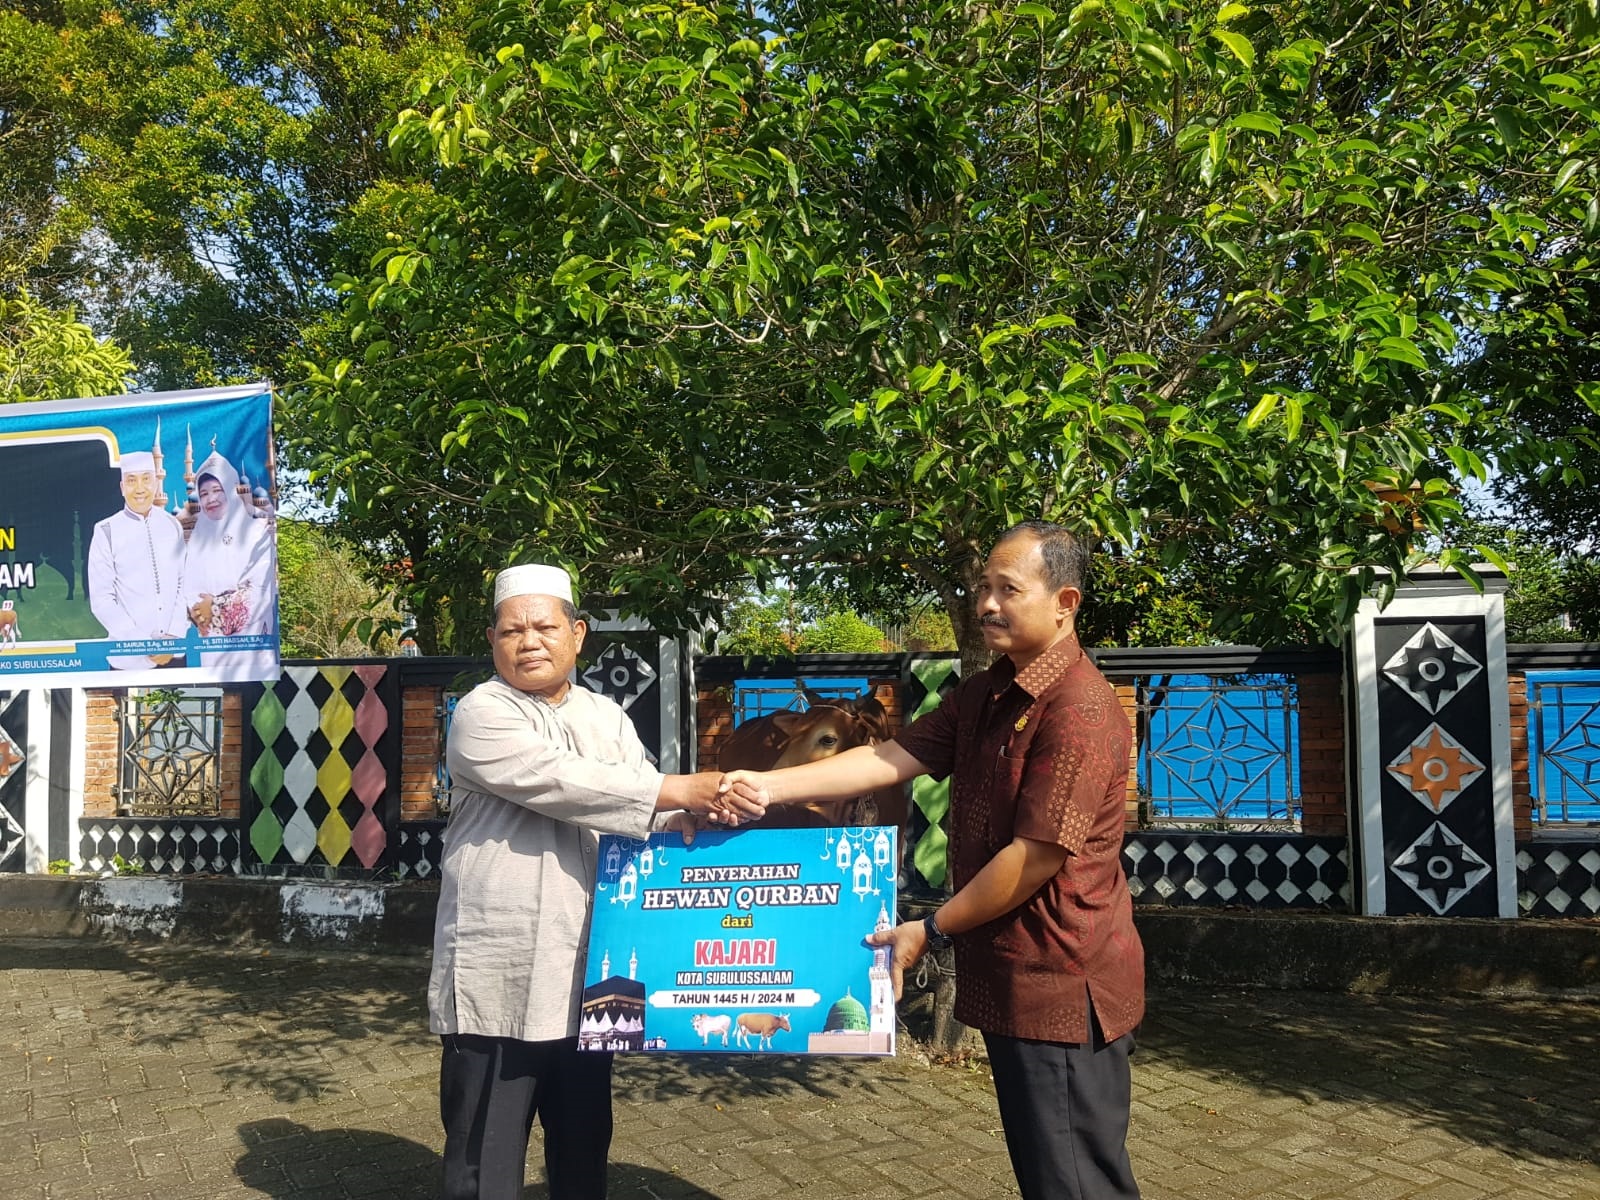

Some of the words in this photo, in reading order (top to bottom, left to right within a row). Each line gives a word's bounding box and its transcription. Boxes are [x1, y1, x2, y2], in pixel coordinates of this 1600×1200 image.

[14, 658, 82, 669] SUBULUSSALAM
[682, 864, 800, 883] PENYERAHAN
[642, 888, 731, 909] HEWAN
[735, 884, 840, 910] QURBAN
[721, 914, 753, 928] dari
[695, 939, 776, 966] KAJARI
[676, 971, 703, 985] KOTA
[706, 971, 793, 985] SUBULUSSALAM
[672, 993, 710, 1004] TAHUN
[714, 993, 738, 1004] 1445
[740, 993, 749, 1003] H
[757, 993, 783, 1003] 2024
[785, 993, 795, 1003] M
